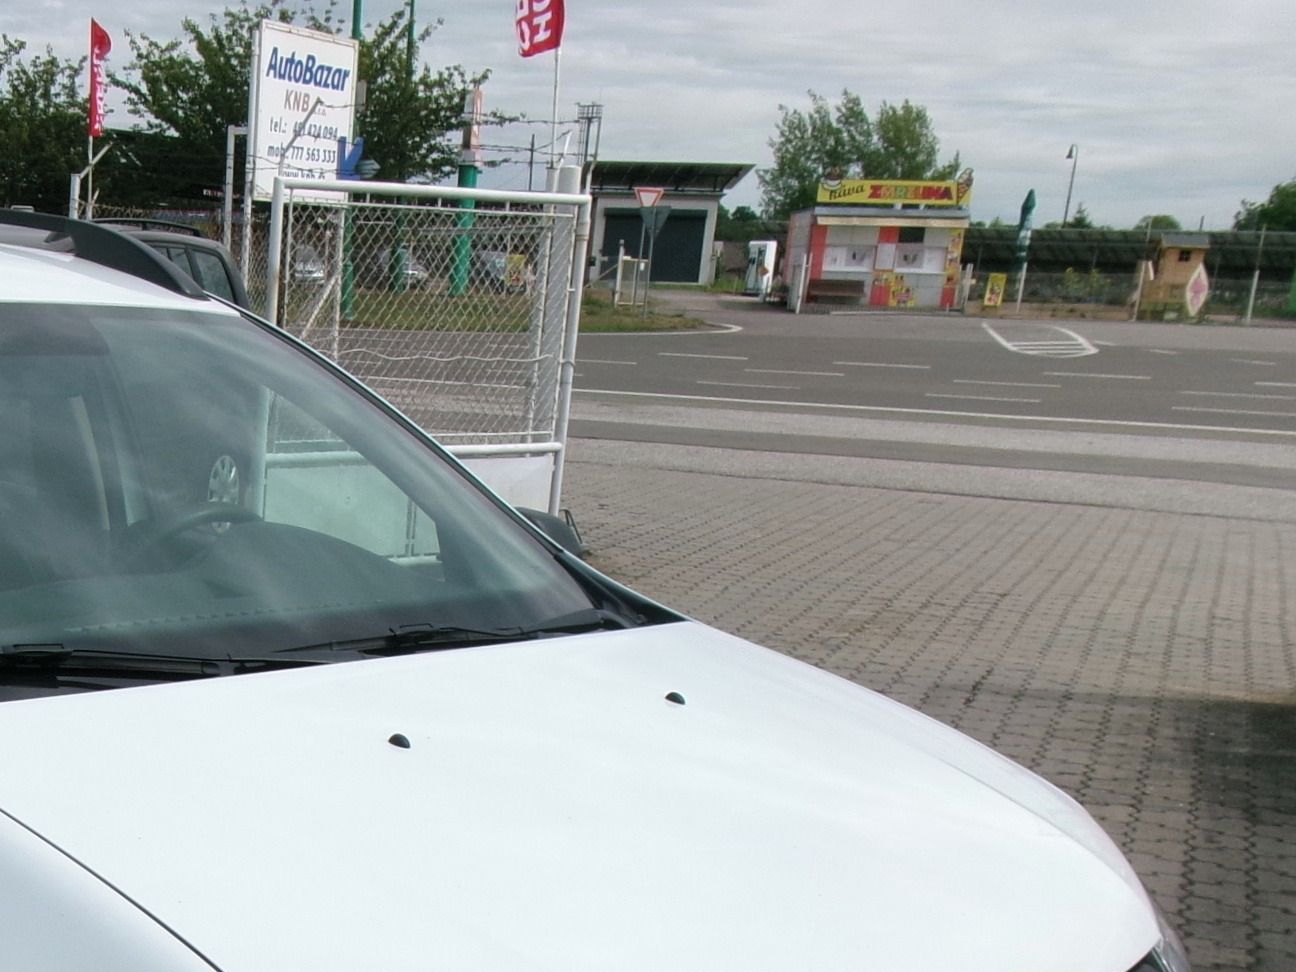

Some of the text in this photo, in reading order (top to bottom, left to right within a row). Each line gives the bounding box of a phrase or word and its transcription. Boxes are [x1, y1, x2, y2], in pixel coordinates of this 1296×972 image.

[266, 46, 351, 92] AutoBazar
[284, 88, 311, 113] KNB
[306, 149, 321, 164] 563
[322, 150, 336, 164] 333
